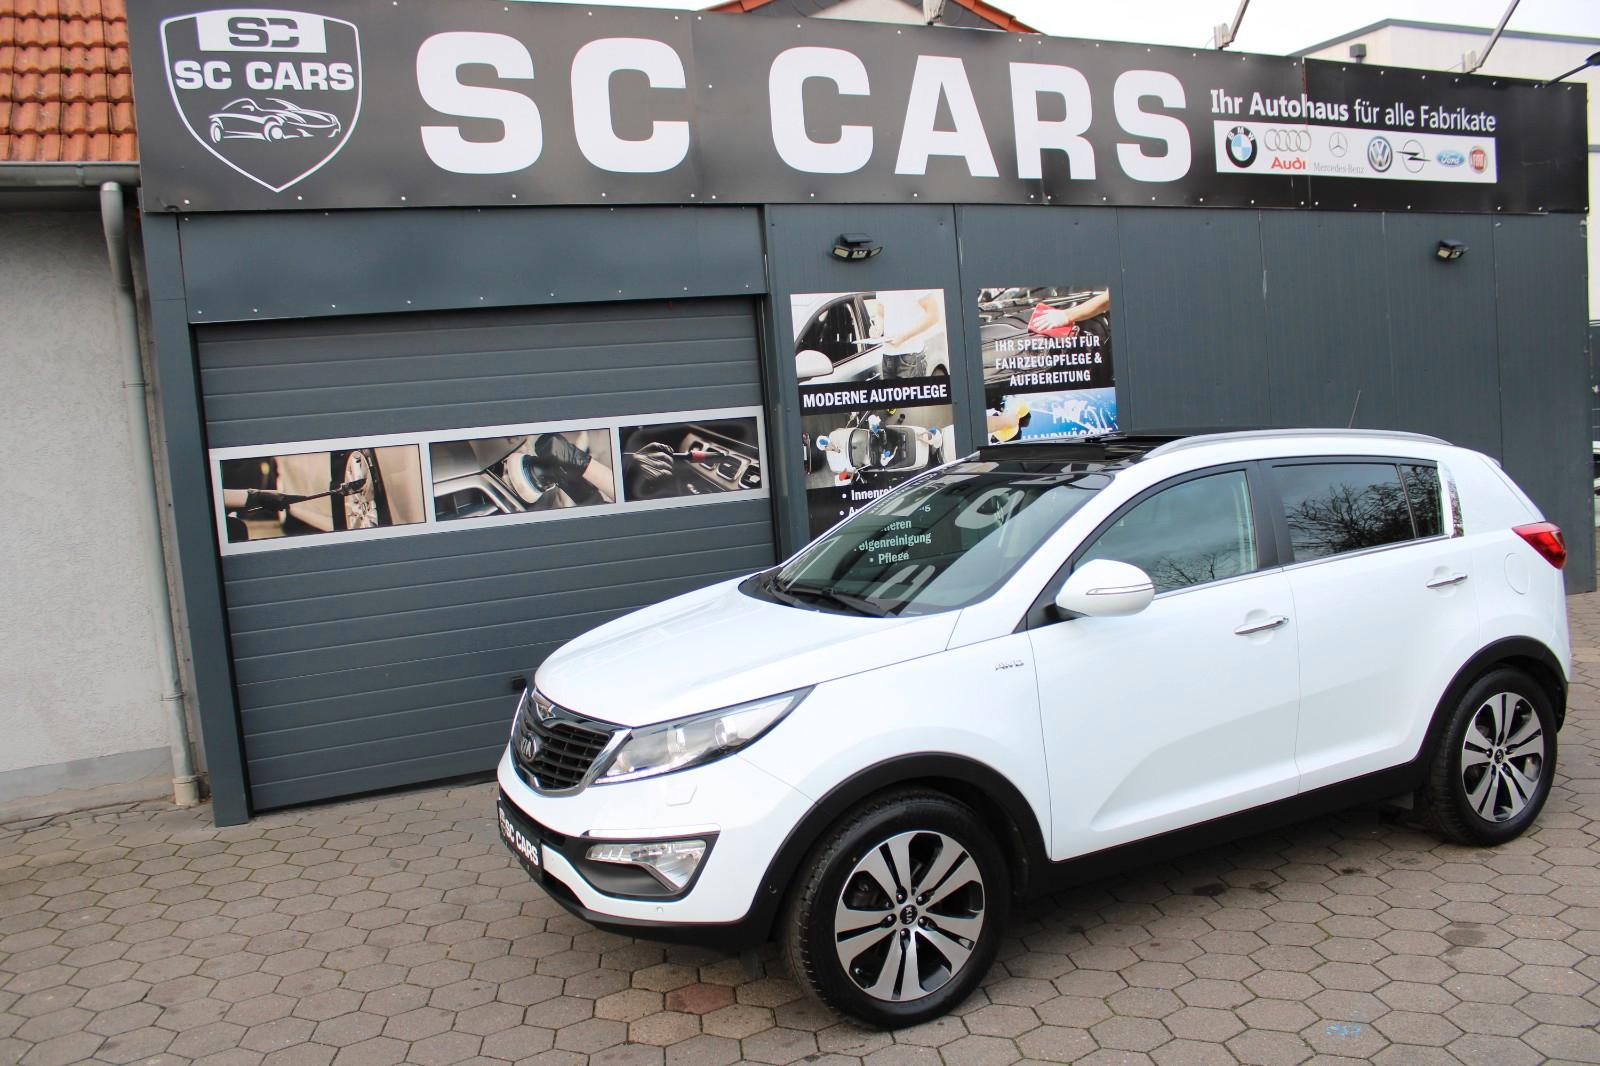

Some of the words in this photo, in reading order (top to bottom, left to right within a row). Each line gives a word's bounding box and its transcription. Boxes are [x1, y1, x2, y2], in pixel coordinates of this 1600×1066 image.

[174, 60, 232, 90] SC
[245, 61, 355, 91] CARS
[416, 31, 690, 174] SC
[768, 46, 1192, 182] CARS
[1210, 89, 1243, 114] Ihr
[1249, 92, 1349, 121] Autohaus
[1354, 98, 1380, 123] für
[1385, 102, 1415, 127] alle
[1420, 105, 1496, 132] Fabrikate
[1271, 157, 1306, 170] Audi
[995, 339, 1014, 352] IHR
[1017, 337, 1077, 351] SPEZIALIST
[1080, 334, 1100, 348] FÜR
[995, 353, 1092, 369] FAHRZEUGPFLEGE
[1094, 352, 1102, 364] &
[1010, 370, 1091, 387] AUFBEREITUNG
[803, 389, 868, 408] MODERNE
[869, 384, 948, 403] AUTOPFLEGE
[878, 552, 909, 565] Pflege
[515, 830, 539, 866] CARS
